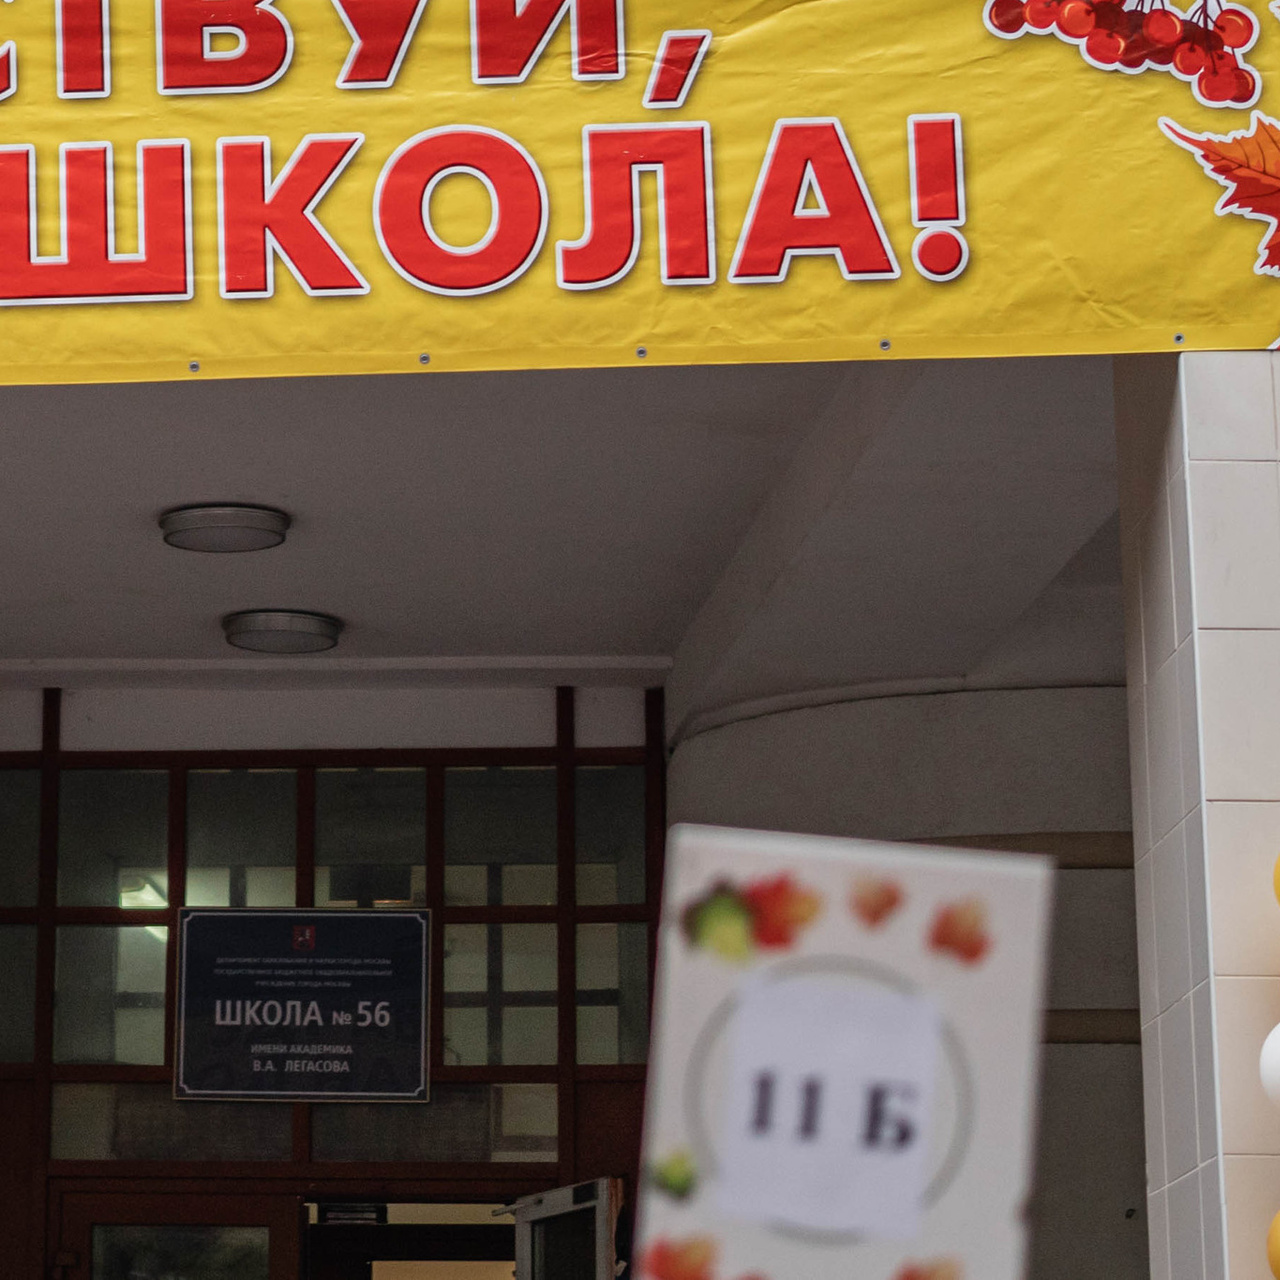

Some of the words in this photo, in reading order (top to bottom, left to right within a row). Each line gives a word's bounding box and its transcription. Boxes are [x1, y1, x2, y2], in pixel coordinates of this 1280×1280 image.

[215, 1000, 323, 1026] ШКОЛА
[332, 1011, 352, 1025] №
[357, 1001, 391, 1027] 56
[251, 1044, 287, 1054] ИМЕНИ
[289, 1044, 353, 1054] АКАДЕМИКА
[253, 1060, 277, 1072] В.А.
[284, 1060, 350, 1072] ЛЕГАСОВА
[861, 1078, 919, 1151] Б
